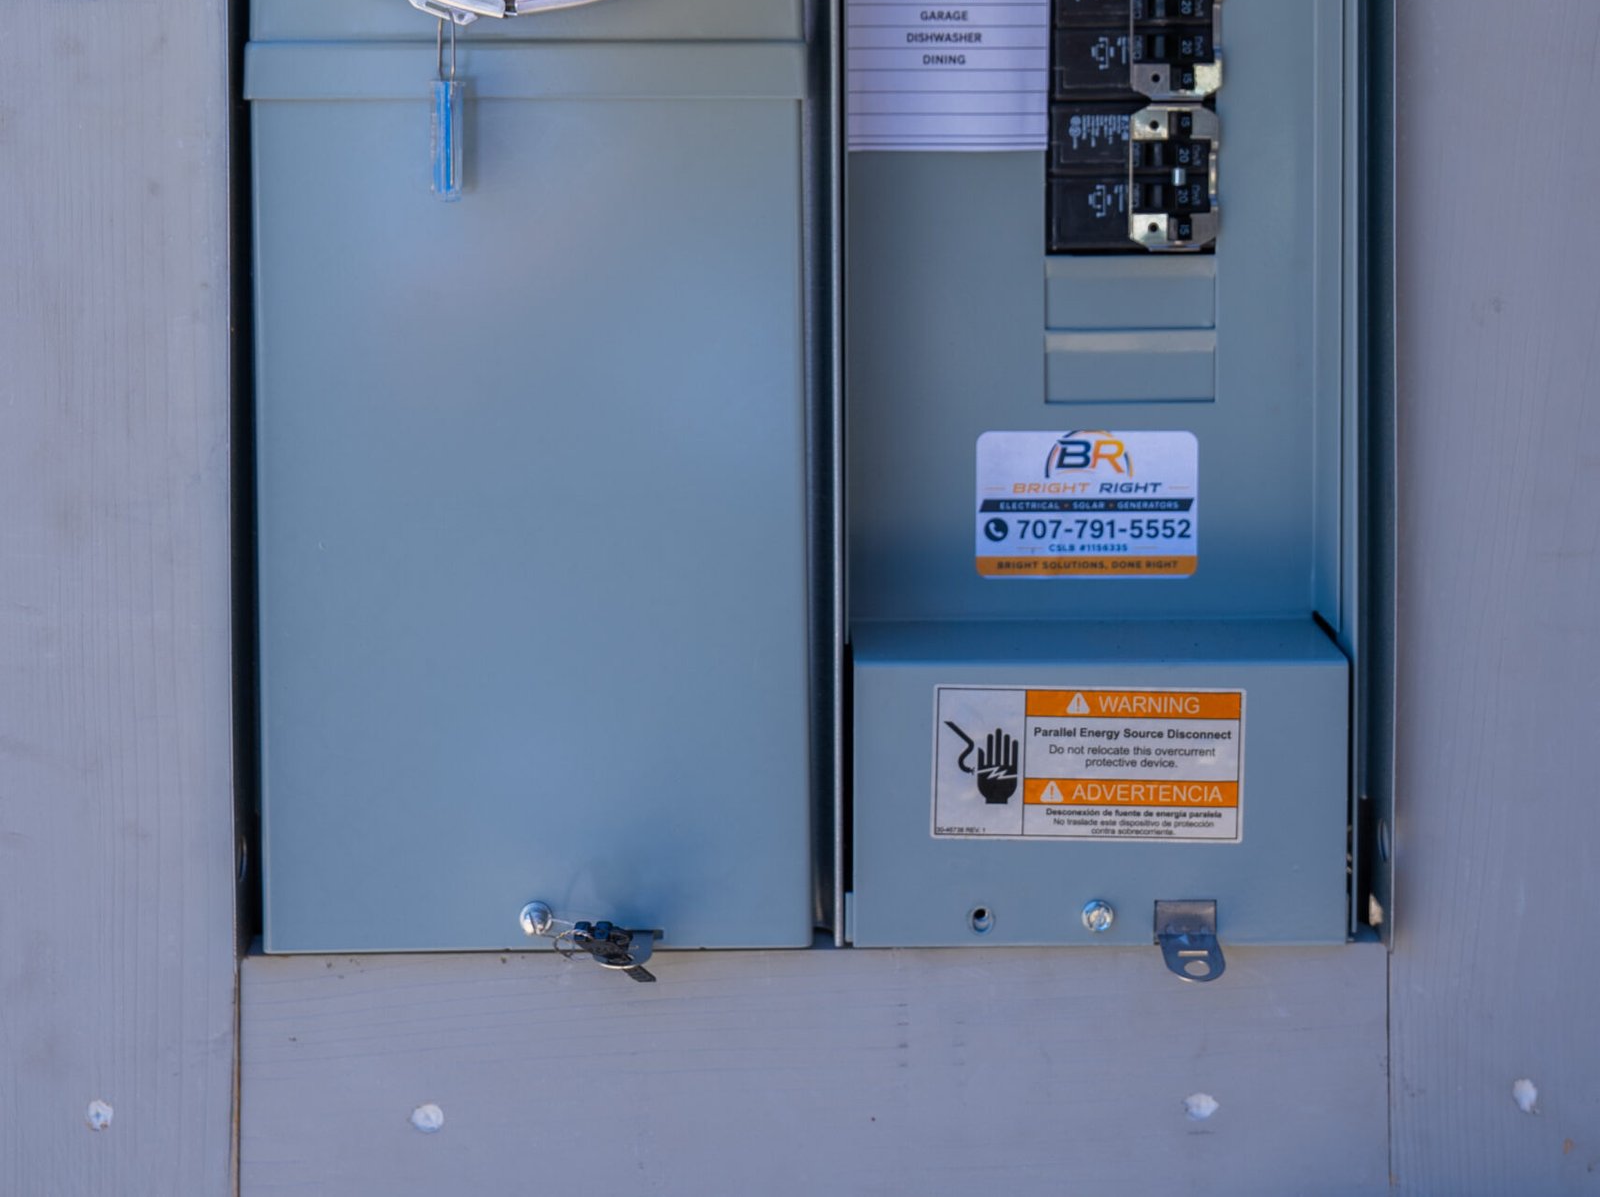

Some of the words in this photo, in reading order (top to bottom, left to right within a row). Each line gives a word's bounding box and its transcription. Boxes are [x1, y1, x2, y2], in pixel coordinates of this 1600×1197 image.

[1181, 0, 1192, 15] 20
[920, 11, 968, 21] GARAGE
[906, 33, 982, 43] DISHWASHER
[1182, 40, 1192, 54] 20
[922, 55, 966, 65] DINING
[1183, 73, 1192, 84] 15
[1181, 117, 1190, 128] 15
[1178, 149, 1189, 163] 20
[1178, 189, 1188, 203] 20
[1179, 224, 1189, 235] 15
[1056, 439, 1125, 473] BR
[1013, 482, 1090, 493] BRIGHT
[1099, 482, 1162, 493] RIGHT
[1000, 502, 1060, 510] ELECTRICAL
[1072, 501, 1105, 510] SOLAR
[1117, 501, 1179, 510] GENERATORS
[1017, 519, 1192, 540] 707-791-5552
[1048, 544, 1075, 552] CSLB
[997, 561, 1038, 569] BRIGHT
[1111, 560, 1142, 569] DONE
[1145, 560, 1178, 569] RIGHT
[1099, 695, 1200, 714] WARNING
[1033, 726, 1076, 738] Parallel
[1079, 727, 1120, 740] Energy
[1123, 728, 1163, 739] Source
[1167, 728, 1232, 740] Disconnect
[1049, 744, 1065, 755] Do
[1066, 745, 1085, 755] not
[1087, 745, 1130, 756] relocate
[1133, 745, 1152, 756] this
[1154, 747, 1216, 757] overcurrent
[1085, 757, 1137, 770] protective
[1140, 757, 1178, 768] device.
[1072, 784, 1223, 803] ADVERTENCIA
[1045, 807, 1100, 817] Desconexión
[1102, 809, 1113, 818] de
[1115, 809, 1143, 818] fuente
[1144, 810, 1155, 818] de
[1189, 810, 1222, 821] paralela
[1053, 817, 1064, 826] No
[1066, 818, 1098, 827] traslade
[1100, 819, 1117, 827] este
[1118, 819, 1160, 829] dispositivo
[1161, 820, 1172, 828] de
